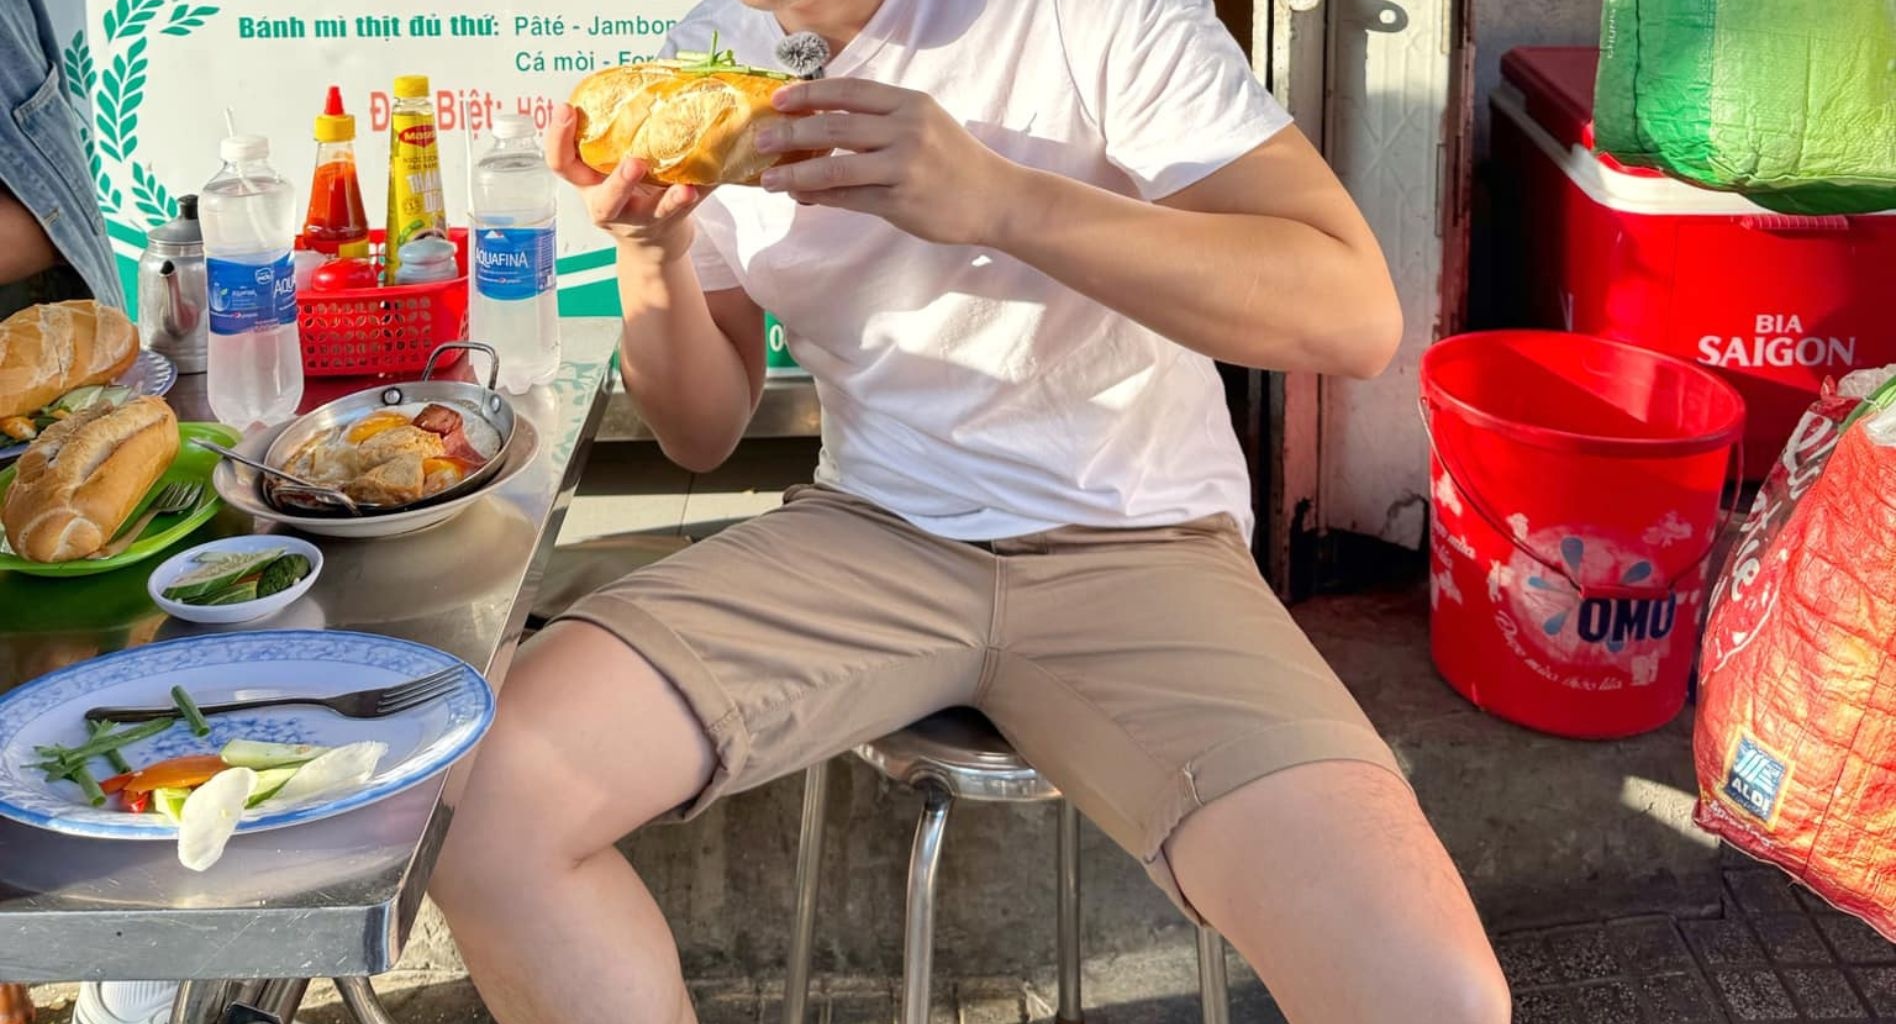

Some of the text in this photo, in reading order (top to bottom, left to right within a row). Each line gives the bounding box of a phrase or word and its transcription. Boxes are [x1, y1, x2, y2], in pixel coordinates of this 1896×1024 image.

[238, 15, 306, 39] Bánh
[314, 15, 348, 38] mì
[355, 15, 402, 42] thịt
[409, 13, 442, 38] đủ
[449, 13, 500, 37] thứ:
[514, 14, 565, 36] Pâté
[515, 51, 545, 73] Cá
[553, 51, 595, 72] mòi
[1754, 314, 1803, 334] BIA
[1696, 335, 1856, 368] SAIGON
[1731, 776, 1771, 815] ALDI
